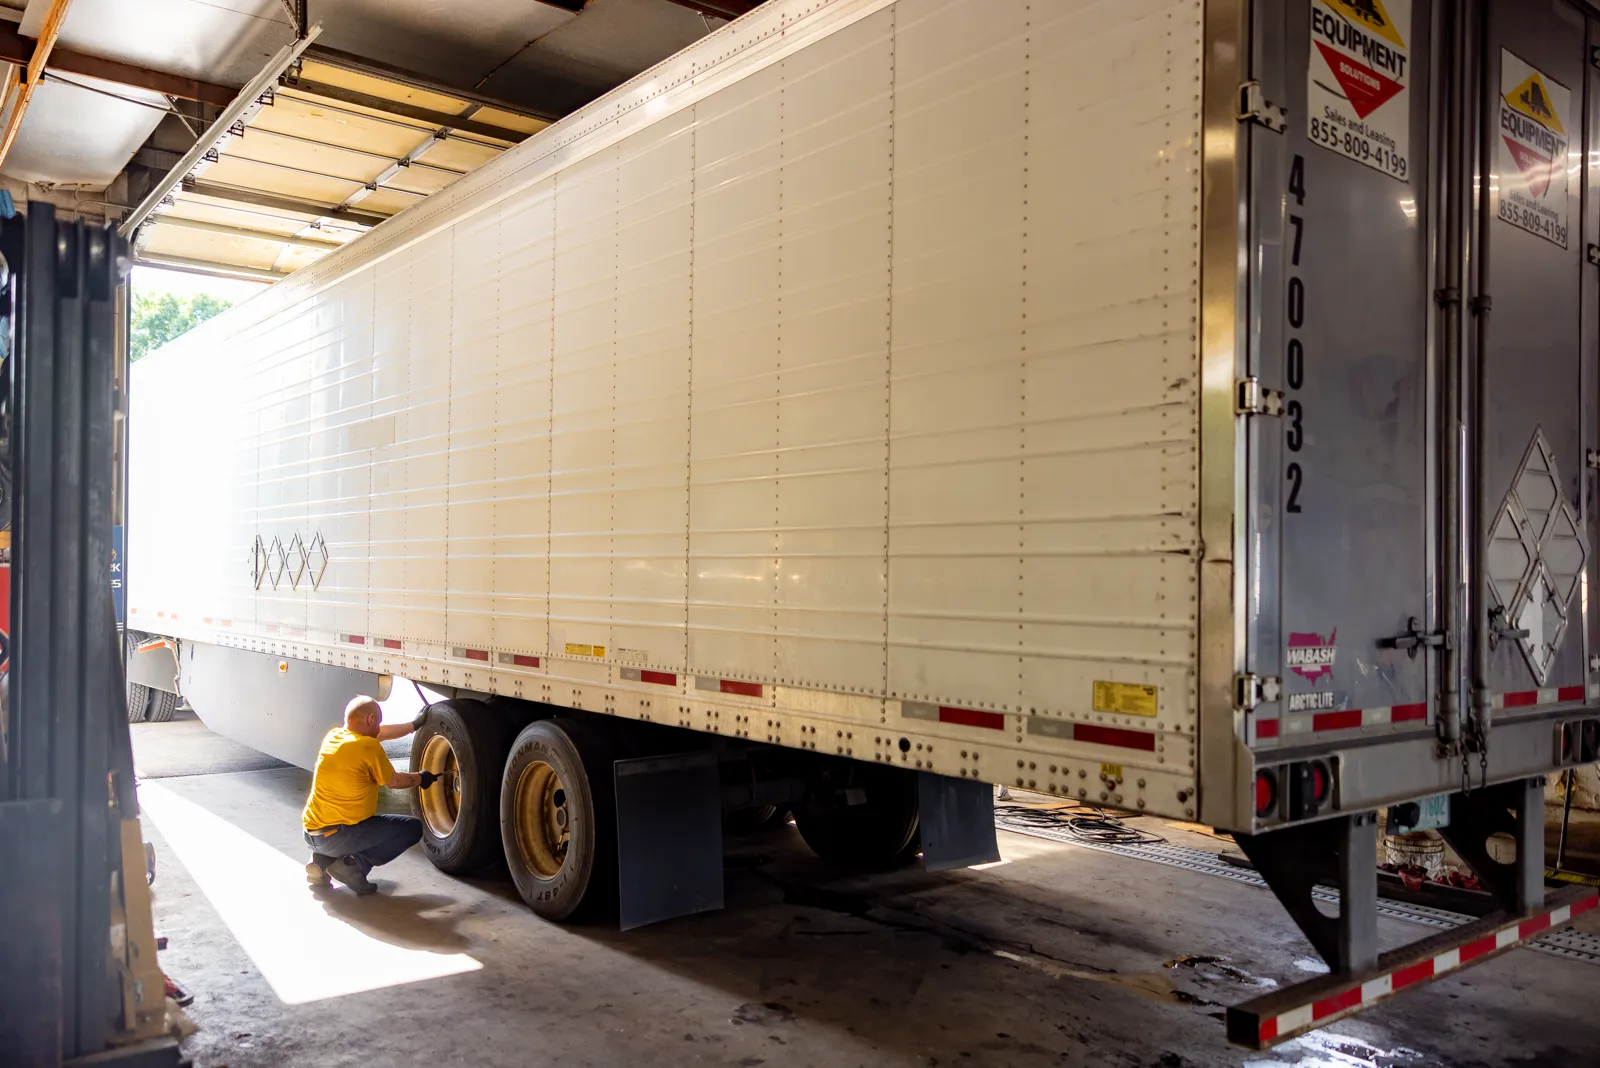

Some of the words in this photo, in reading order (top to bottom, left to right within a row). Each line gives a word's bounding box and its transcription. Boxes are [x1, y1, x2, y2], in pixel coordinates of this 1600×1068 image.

[1312, 7, 1407, 77] EQUIPMENT
[1340, 61, 1381, 91] SOLUTIONS
[1311, 117, 1407, 177] 855-809-4199
[1324, 105, 1347, 128] Sales
[1348, 119, 1365, 135] and
[1365, 124, 1396, 152] Leasing
[1501, 108, 1567, 157] EQUIPMENT
[1500, 201, 1567, 243] 855-809-4199
[1509, 190, 1525, 206] Sales
[1537, 201, 1559, 223] Leasing
[1287, 647, 1337, 666] WABASH
